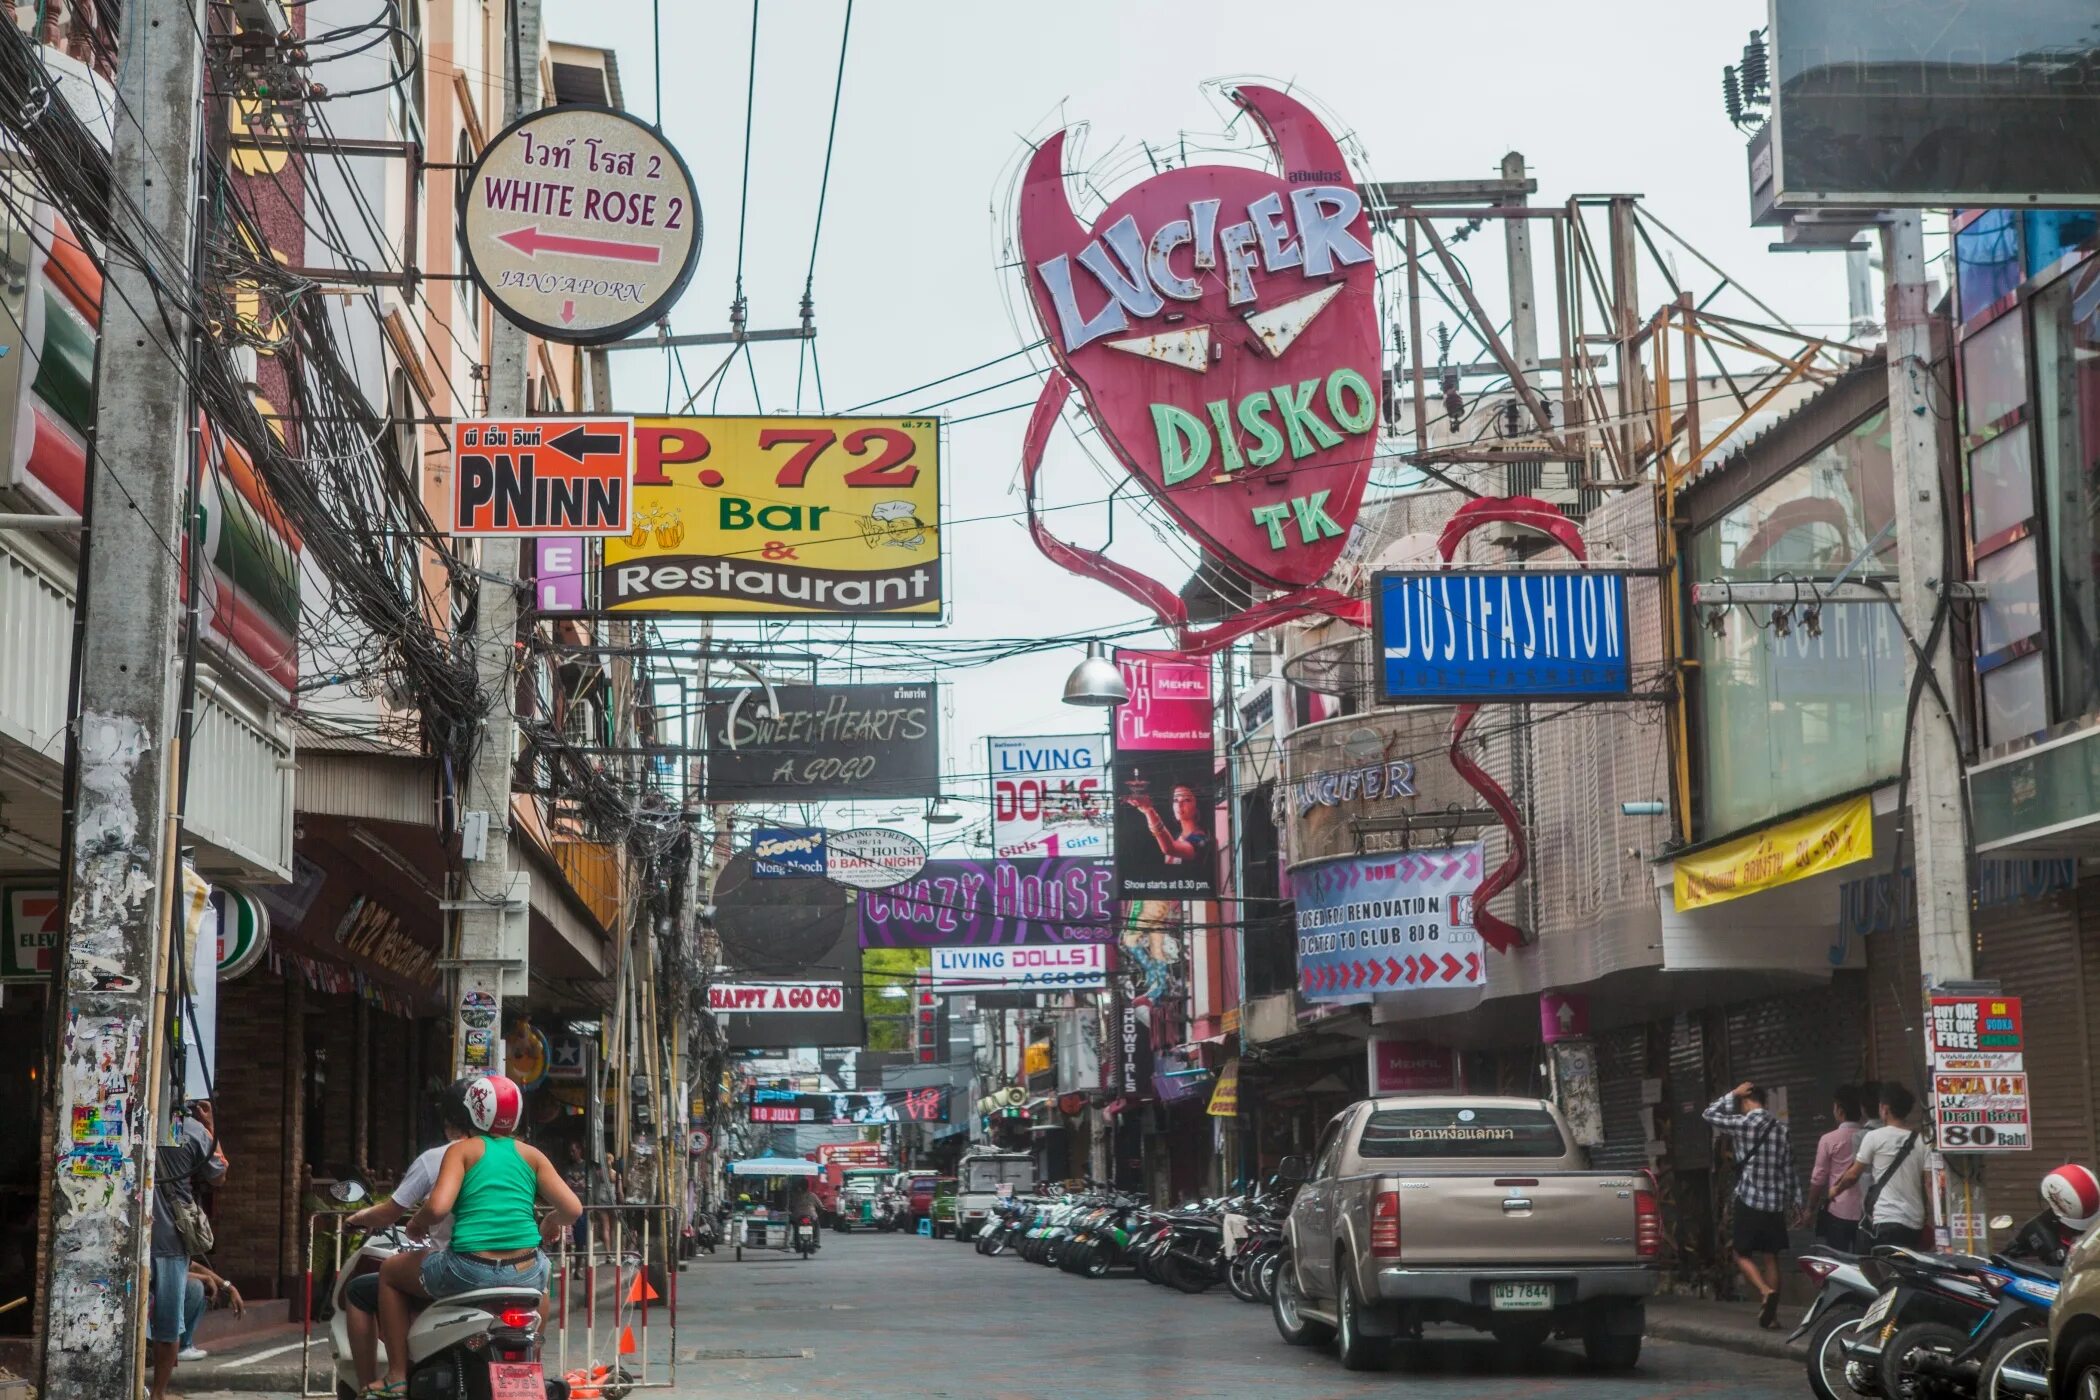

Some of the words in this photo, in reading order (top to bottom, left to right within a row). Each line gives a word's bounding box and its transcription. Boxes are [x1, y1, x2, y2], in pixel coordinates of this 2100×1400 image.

[518, 131, 576, 169] ไวท์
[585, 138, 635, 176] โรส
[647, 155, 662, 179] 2
[485, 177, 574, 217] WHITE
[584, 188, 657, 227] ROSE
[665, 197, 683, 229] 2
[1037, 186, 1374, 355] LUCIFER
[497, 271, 646, 304] JANYAPORN
[1149, 368, 1377, 486] DISKO
[634, 426, 725, 488] P.
[757, 427, 919, 489] 72
[720, 497, 830, 532] Bar
[1251, 489, 1344, 550] TK
[761, 541, 799, 561] &
[617, 562, 931, 607] Restaurant
[1158, 679, 1205, 690] MEHFIL
[773, 759, 795, 782] A
[1002, 748, 1092, 770] LIVING
[1291, 760, 1416, 818] LUCIFER
[871, 846, 921, 856] HOUSE
[1000, 840, 1037, 858] Girls
[1039, 833, 1059, 858] 1
[1066, 835, 1100, 849] Girls
[756, 861, 786, 875] Nong
[884, 856, 924, 867] NIGHT
[1124, 879, 1147, 890] Show
[1148, 879, 1168, 890] starts
[1169, 880, 1177, 890] at
[1178, 879, 1195, 889] 8.30
[1196, 881, 1210, 892] pm.
[867, 872, 984, 932] CRAZY
[995, 864, 1113, 922] HOUSE
[1347, 897, 1440, 922] RENOVATION
[20, 932, 58, 948] ELEV
[1340, 931, 1357, 950] TO
[1361, 927, 1401, 946] CLUB
[1408, 923, 1440, 942] 808
[941, 952, 1005, 969] LIVING
[1012, 949, 1086, 967] DOLLS
[1088, 944, 1101, 967] 1
[709, 988, 768, 1009] HAPPY
[772, 988, 787, 1008] A
[1933, 1005, 1955, 1019] BUY
[1955, 1003, 1978, 1019] ONE
[1935, 1019, 1954, 1032] GET
[1956, 1019, 1976, 1033] ONE
[1122, 1007, 1137, 1092] SHOWGIRLS
[1936, 1032, 1978, 1049] FREE
[770, 1107, 797, 1121] JULY
[1987, 1108, 2023, 1122] Beer
[1943, 1125, 1996, 1146] 80
[1997, 1130, 2027, 1146] Baht
[1519, 1283, 1548, 1299] 7844
